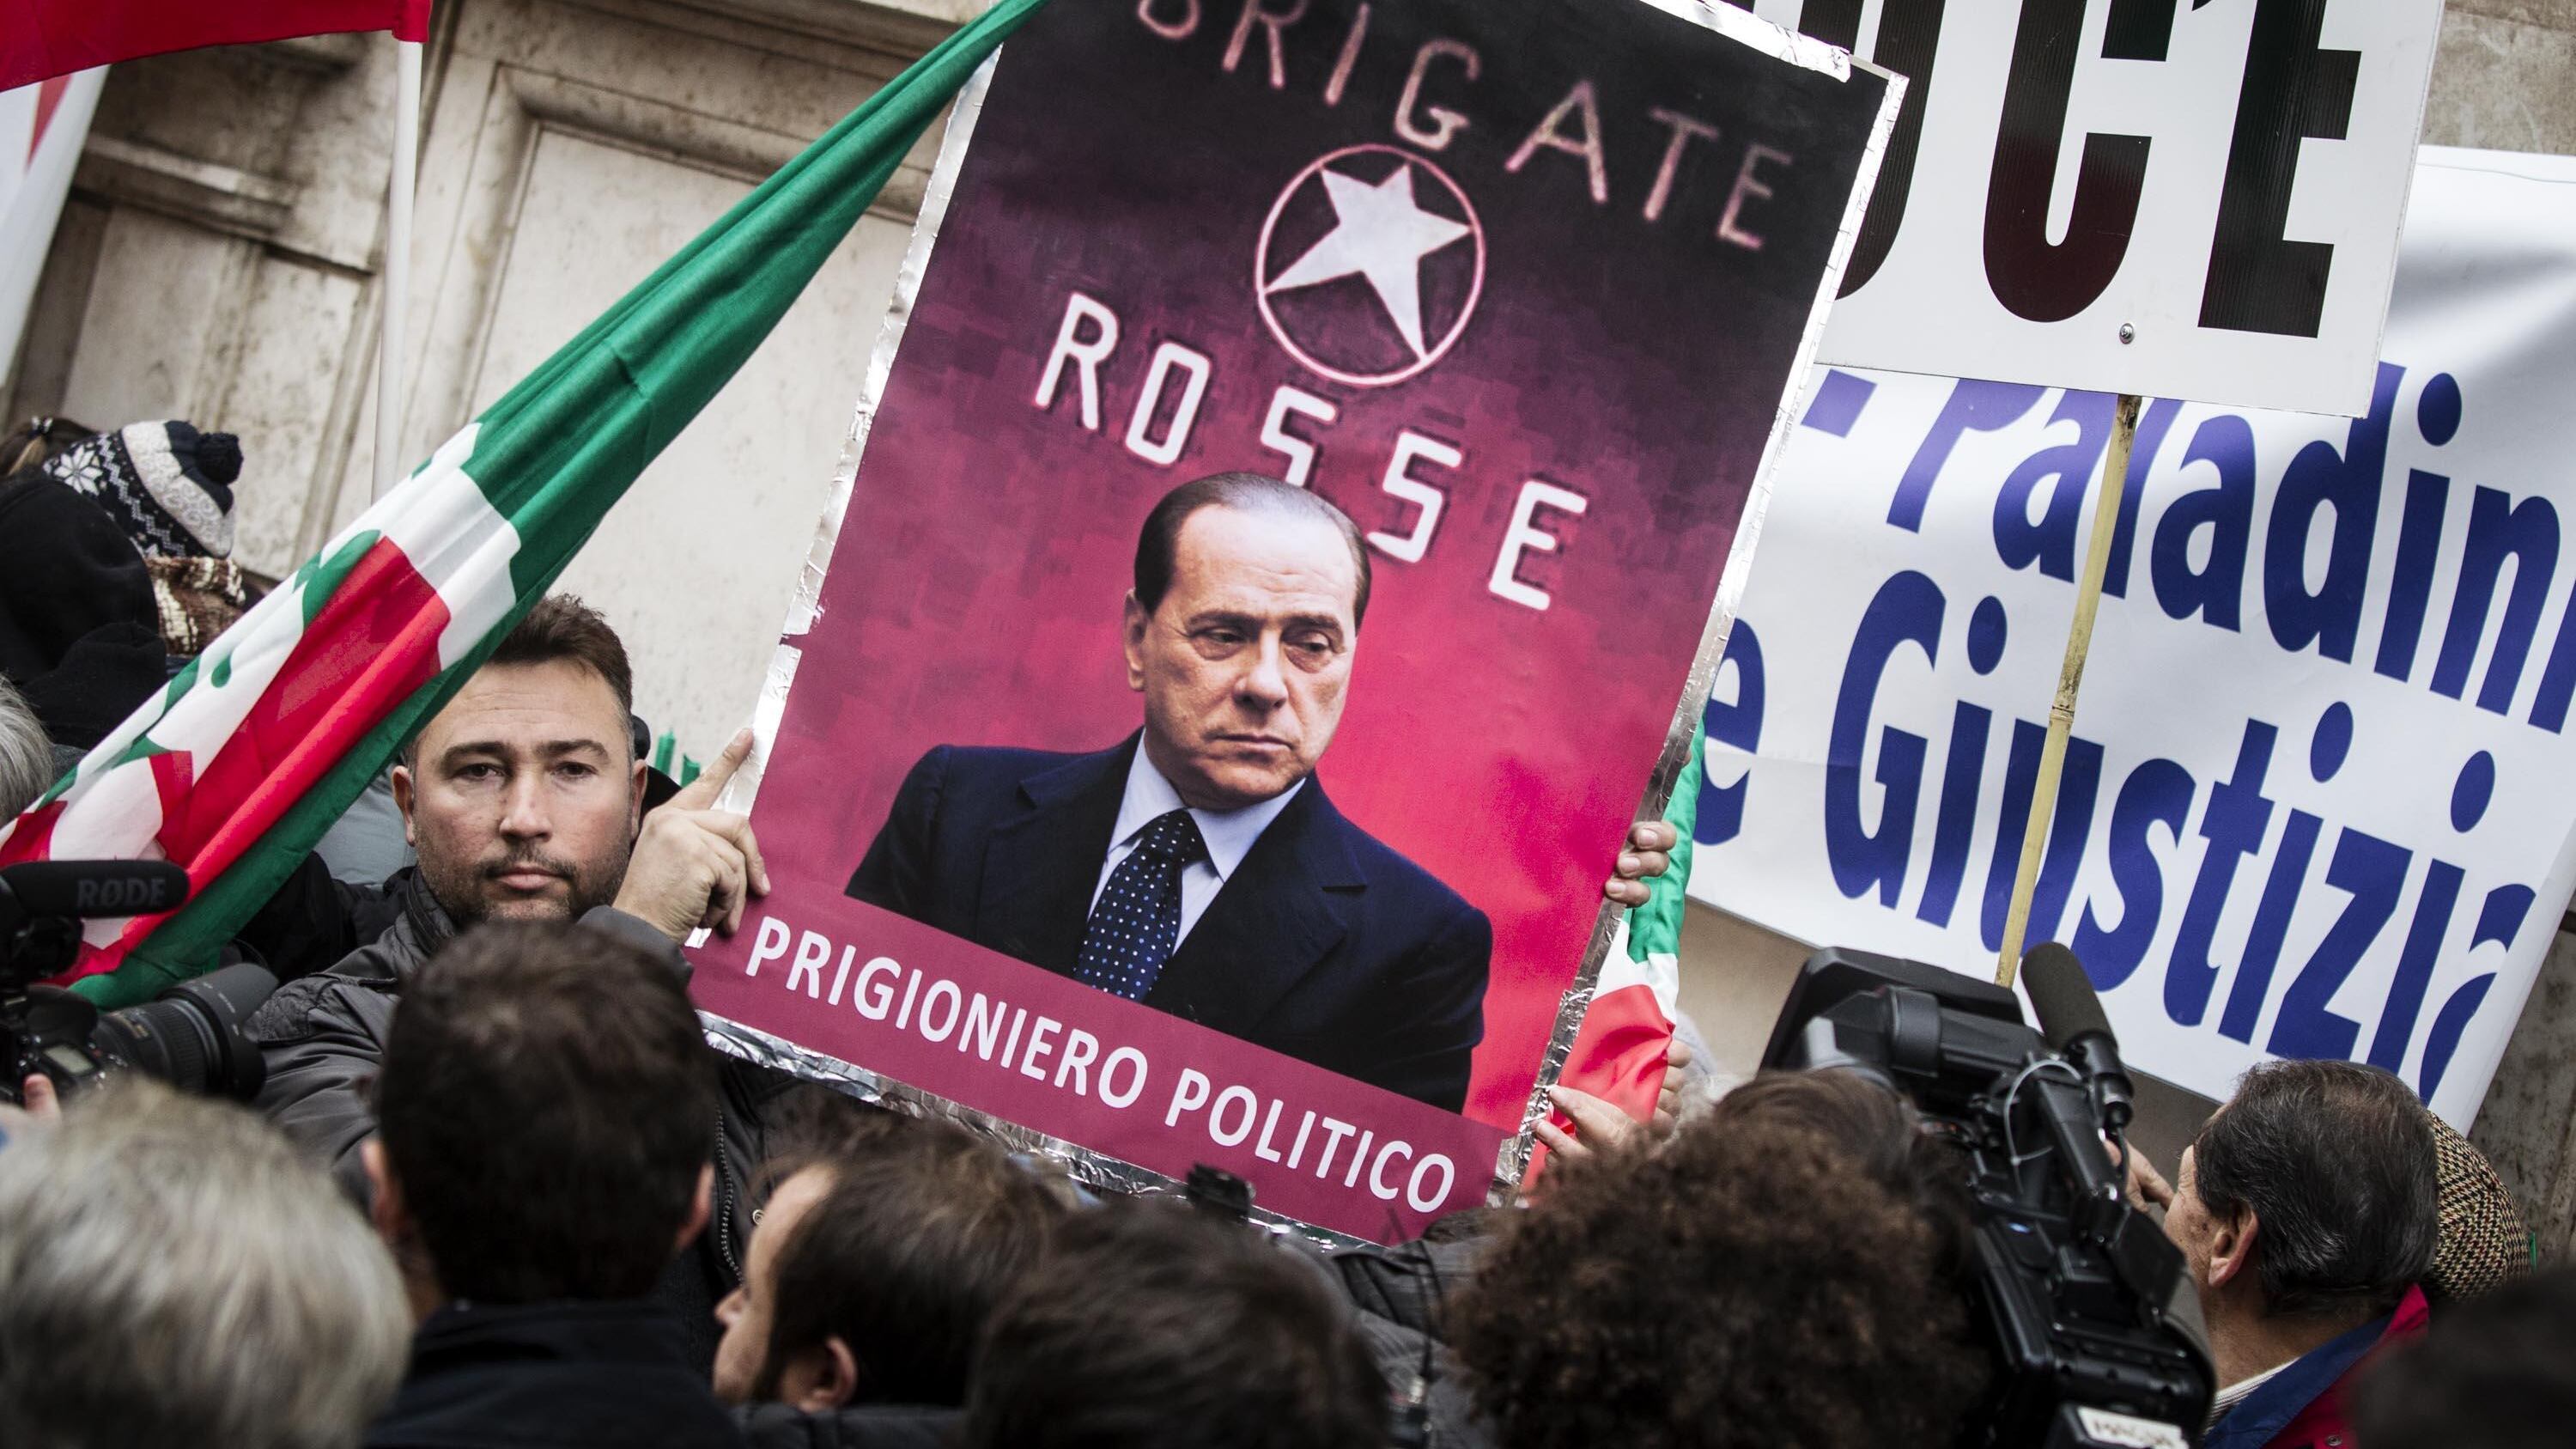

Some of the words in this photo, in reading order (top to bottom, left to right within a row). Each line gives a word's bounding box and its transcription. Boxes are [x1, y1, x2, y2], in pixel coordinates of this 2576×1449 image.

[1034, 292, 1588, 610] ROSSE
[745, 915, 1148, 1109] PRIGIONIERO
[1164, 1068, 1456, 1214] POLITICO
